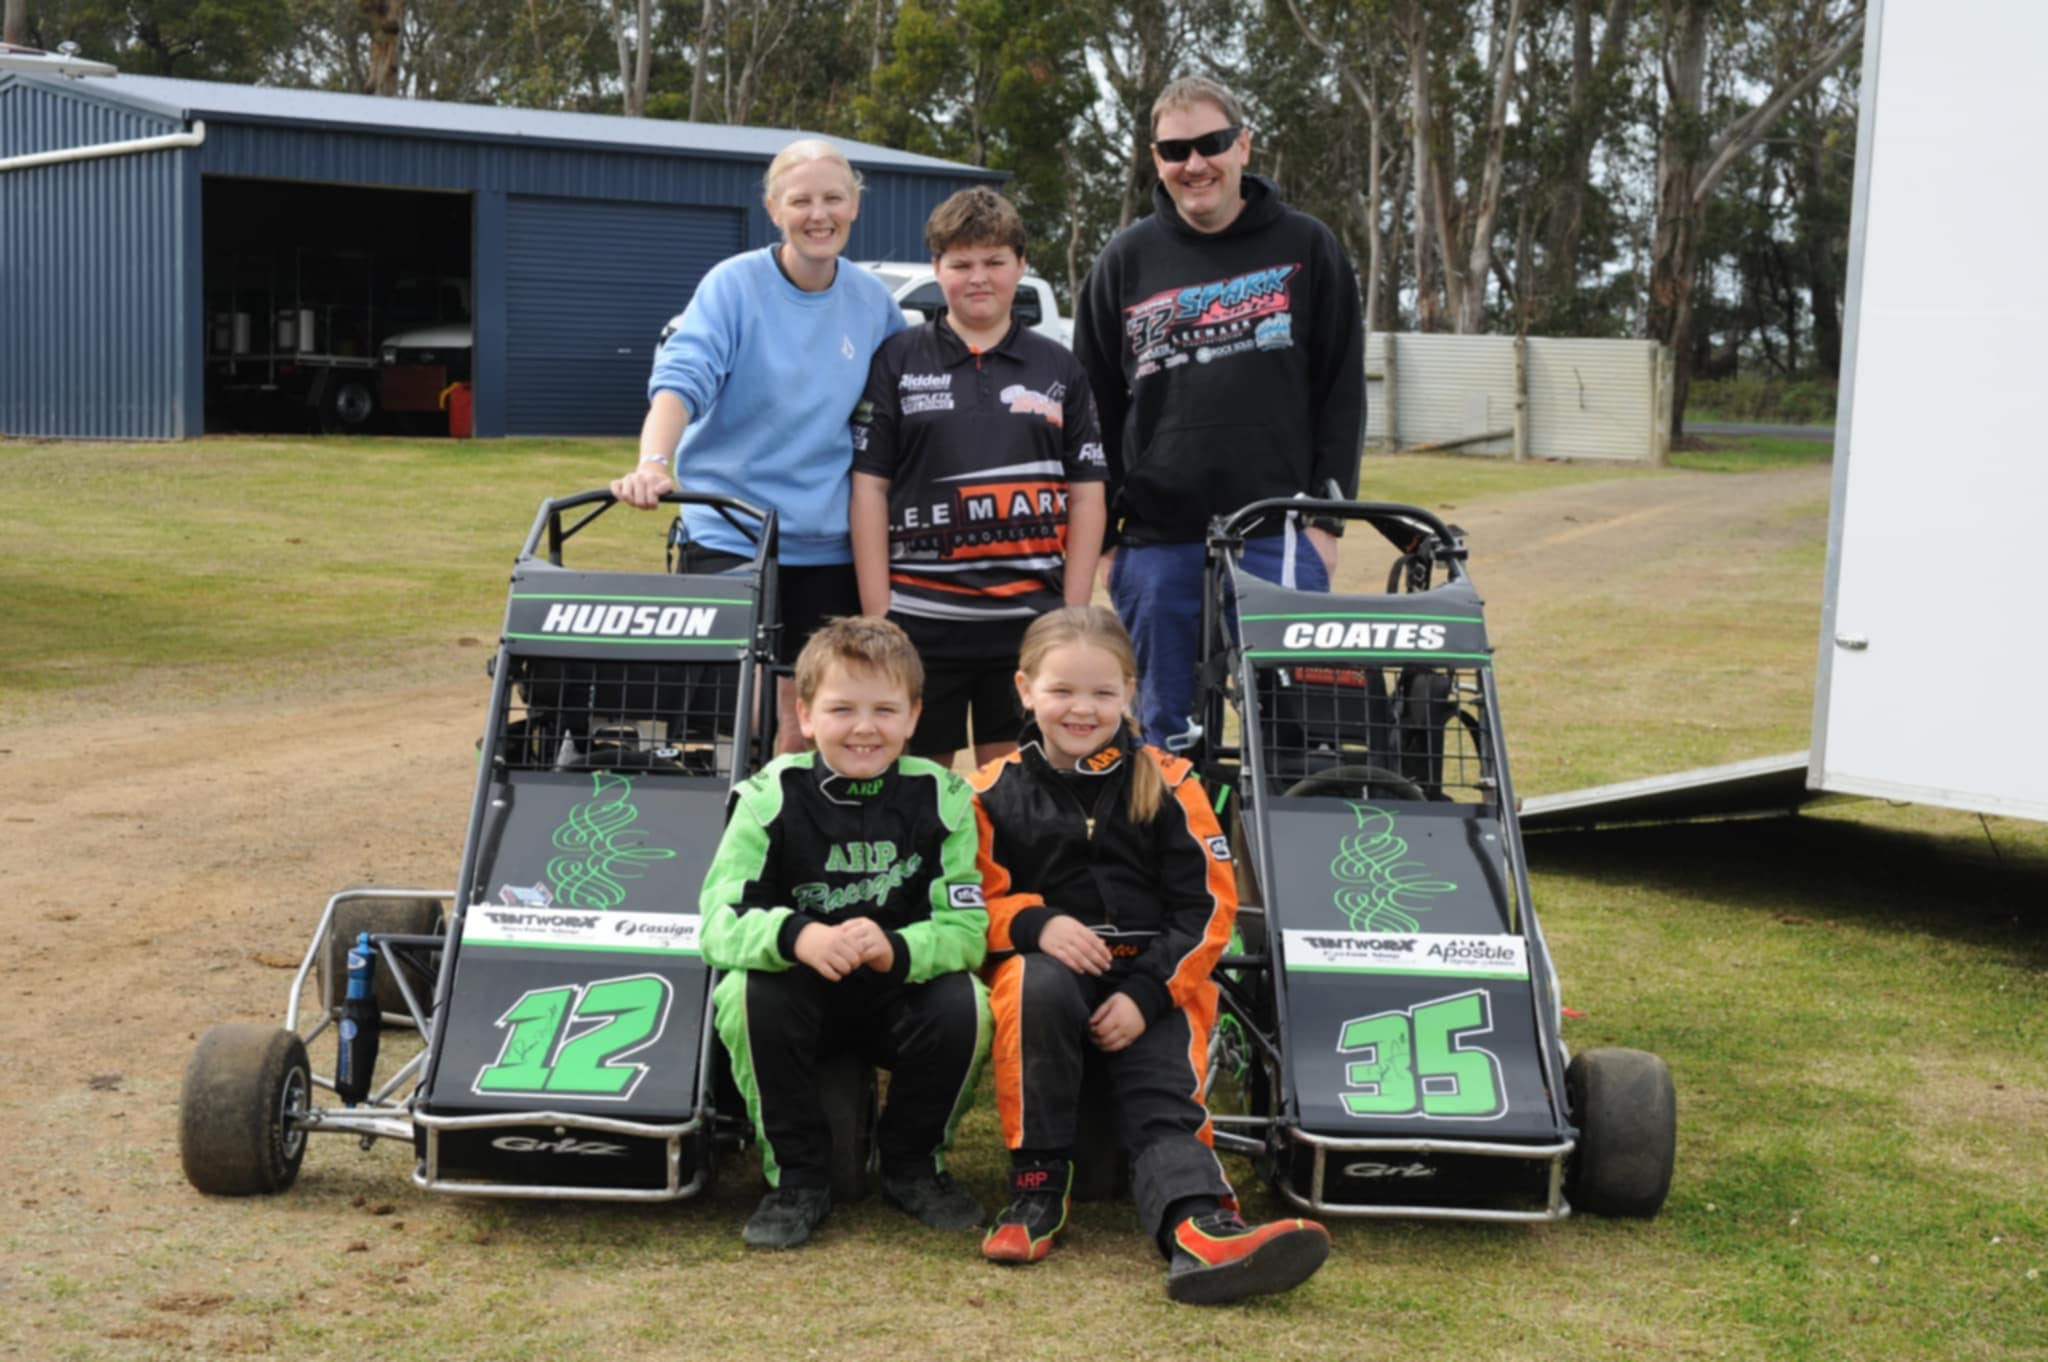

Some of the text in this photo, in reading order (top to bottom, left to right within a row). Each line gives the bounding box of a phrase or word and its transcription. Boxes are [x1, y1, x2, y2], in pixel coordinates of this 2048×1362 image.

[1176, 265, 1294, 319] SPARK
[541, 603, 718, 637] HUDSON
[1283, 621, 1447, 650] COATES
[848, 778, 884, 797] ARP
[824, 840, 898, 873] ARP
[470, 972, 674, 1101] 12
[1336, 987, 1509, 1121] 35
[1017, 1171, 1048, 1188] ARP
